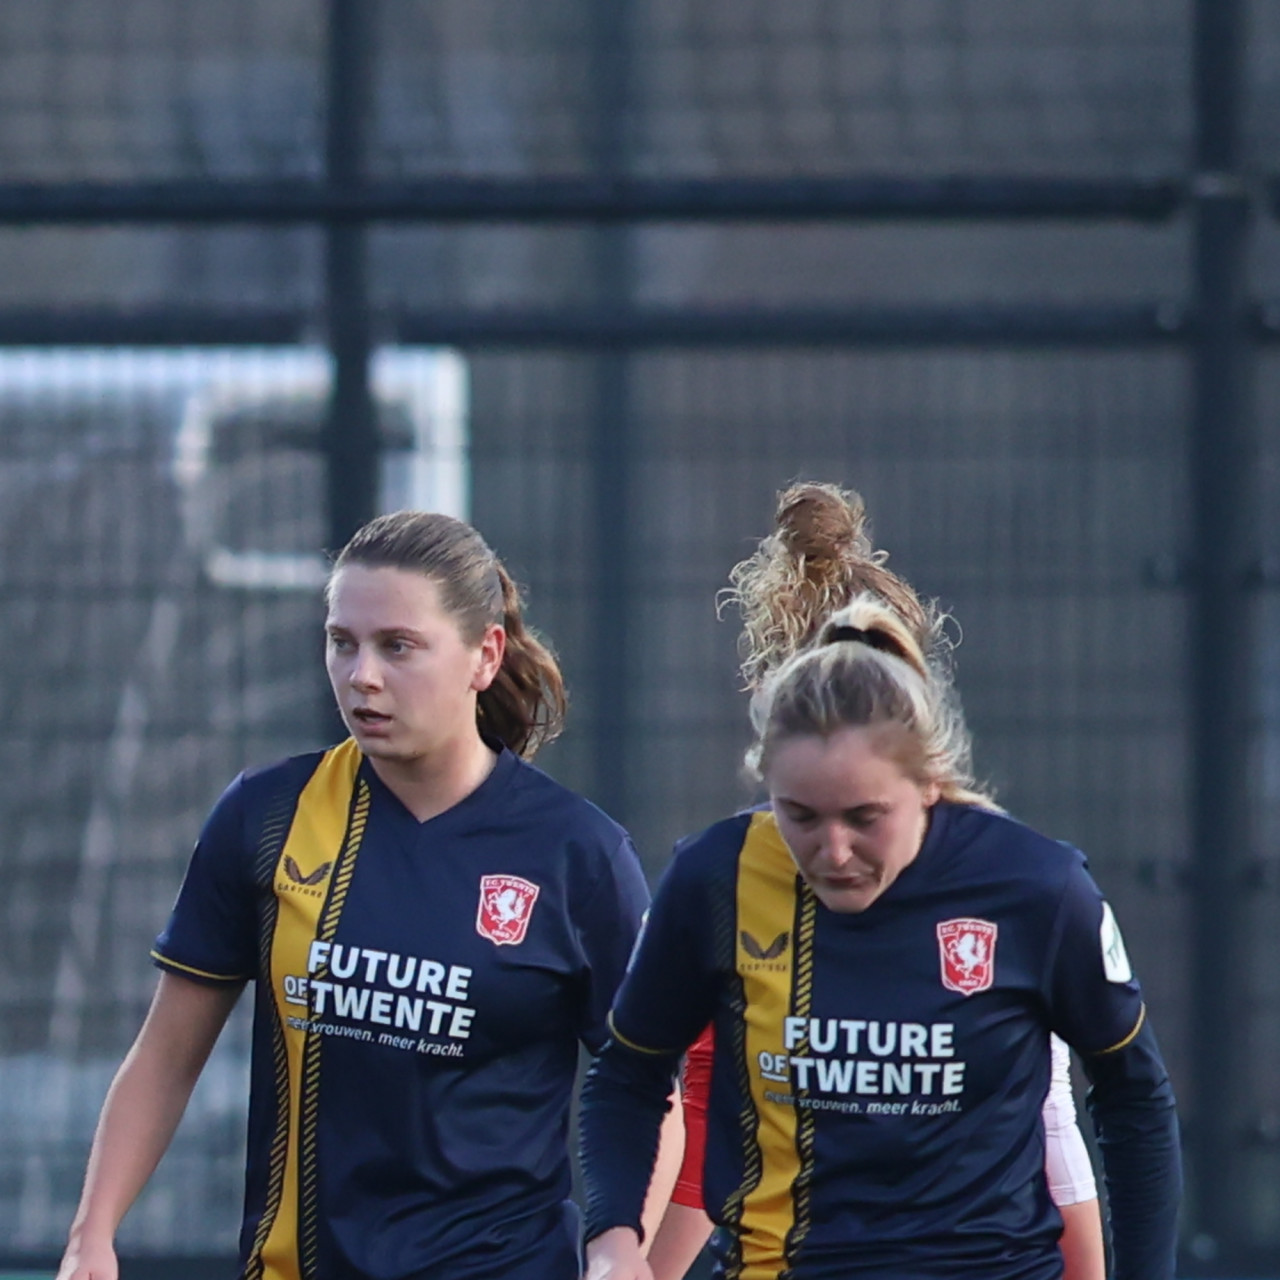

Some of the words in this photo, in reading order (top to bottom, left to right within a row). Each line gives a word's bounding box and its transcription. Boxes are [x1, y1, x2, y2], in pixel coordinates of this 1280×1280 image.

[307, 940, 473, 1001] FUTURE
[283, 975, 308, 997] OF
[310, 981, 476, 1039] TWENTE
[378, 1033, 416, 1051] meer
[784, 1016, 955, 1058] FUTURE
[758, 1052, 789, 1074] OF
[790, 1056, 966, 1096] TWENTE
[866, 1101, 907, 1115] meer
